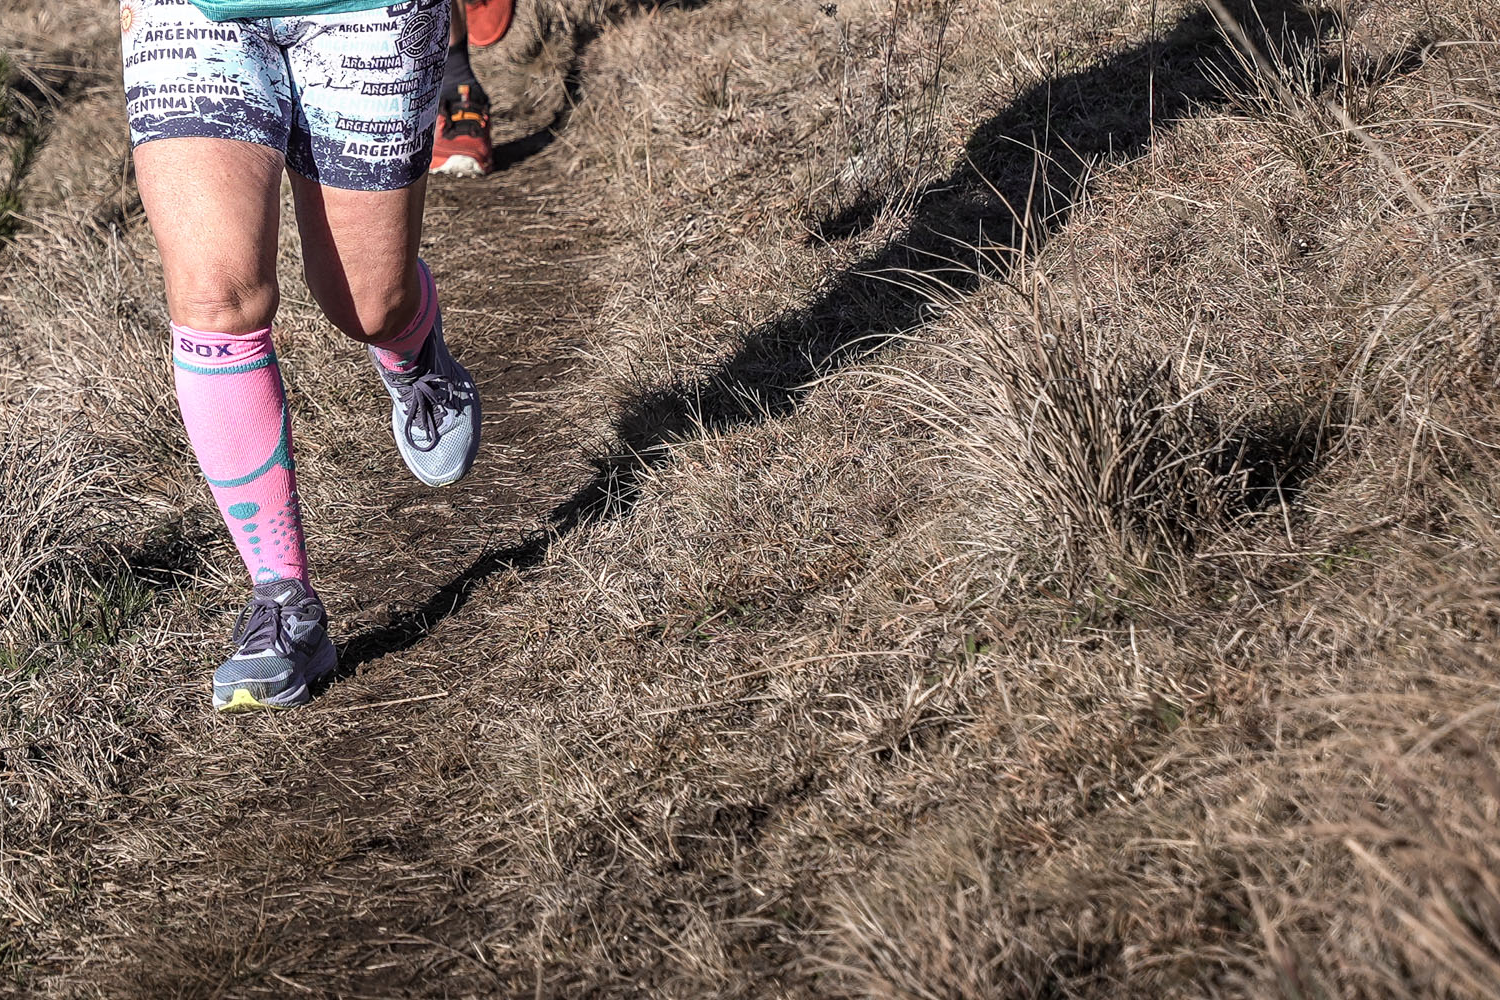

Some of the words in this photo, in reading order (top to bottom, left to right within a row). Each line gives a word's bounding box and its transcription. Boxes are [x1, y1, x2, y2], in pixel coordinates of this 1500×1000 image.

[339, 20, 398, 33] ARGENTINA
[145, 28, 239, 43] ARGENTINA
[342, 56, 402, 69] ARGENTINA
[159, 83, 240, 97] ARGENTINA
[363, 80, 419, 95] ARGENTINA
[337, 119, 403, 133] ARGENTINA
[347, 138, 422, 157] ARGENTINA
[180, 337, 234, 358] SOX
